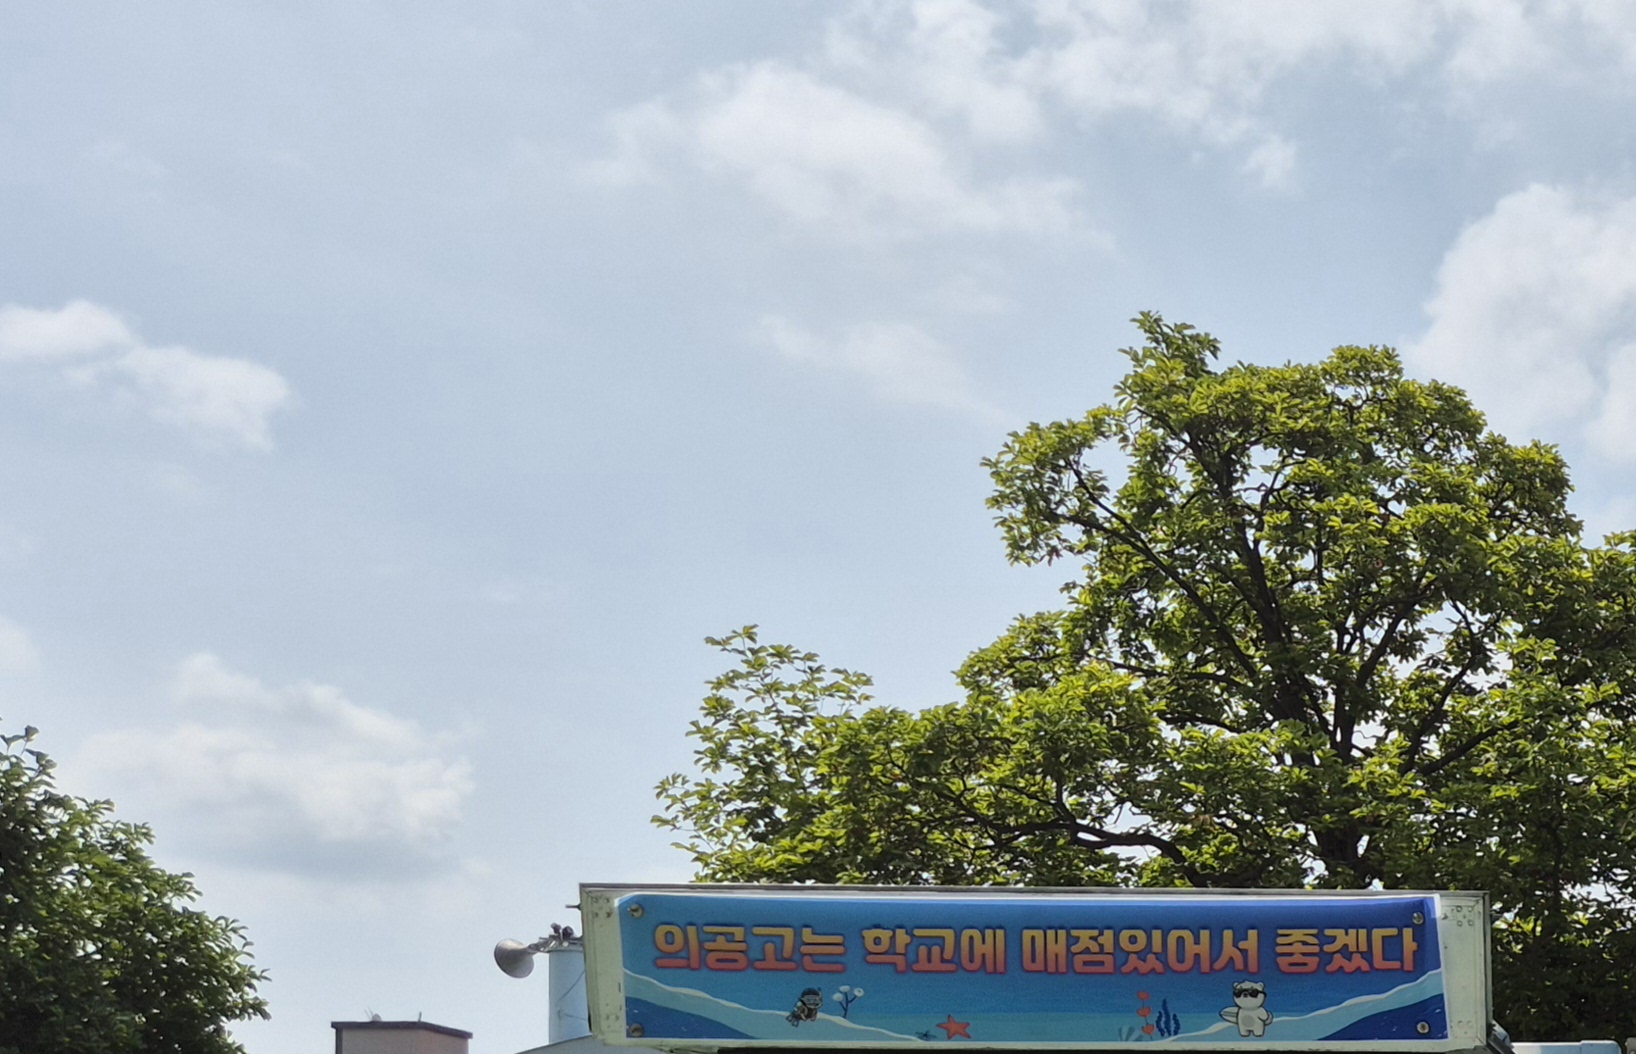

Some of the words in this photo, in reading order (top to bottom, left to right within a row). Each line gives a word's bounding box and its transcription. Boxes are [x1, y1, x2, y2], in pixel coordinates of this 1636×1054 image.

[653, 923, 846, 972] 의공고는
[861, 925, 1006, 974] 학교에
[1021, 928, 1259, 973] 매점있어서
[1275, 927, 1419, 973] 좋겠다
